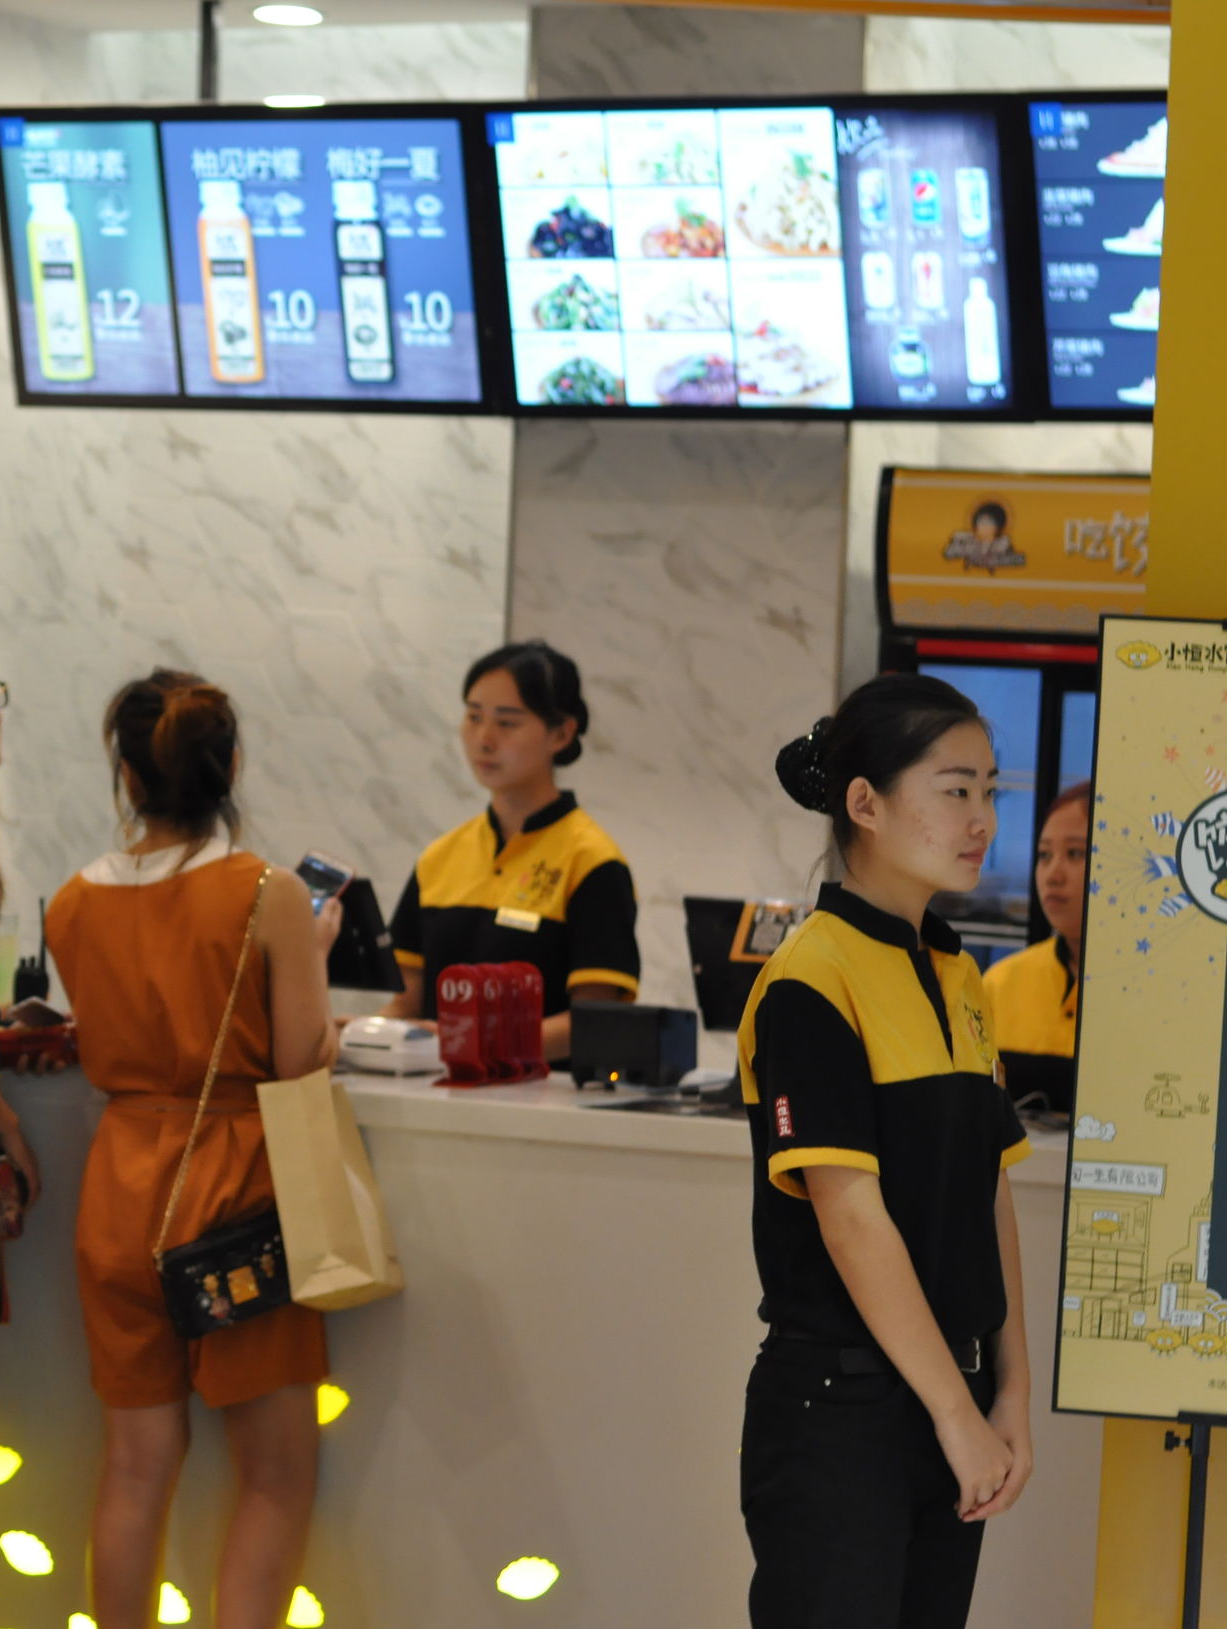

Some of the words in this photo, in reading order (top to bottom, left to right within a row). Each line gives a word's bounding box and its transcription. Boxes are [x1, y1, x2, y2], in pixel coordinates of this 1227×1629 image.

[1164, 642, 1227, 664] 小恒水
[441, 978, 473, 1003] 09
